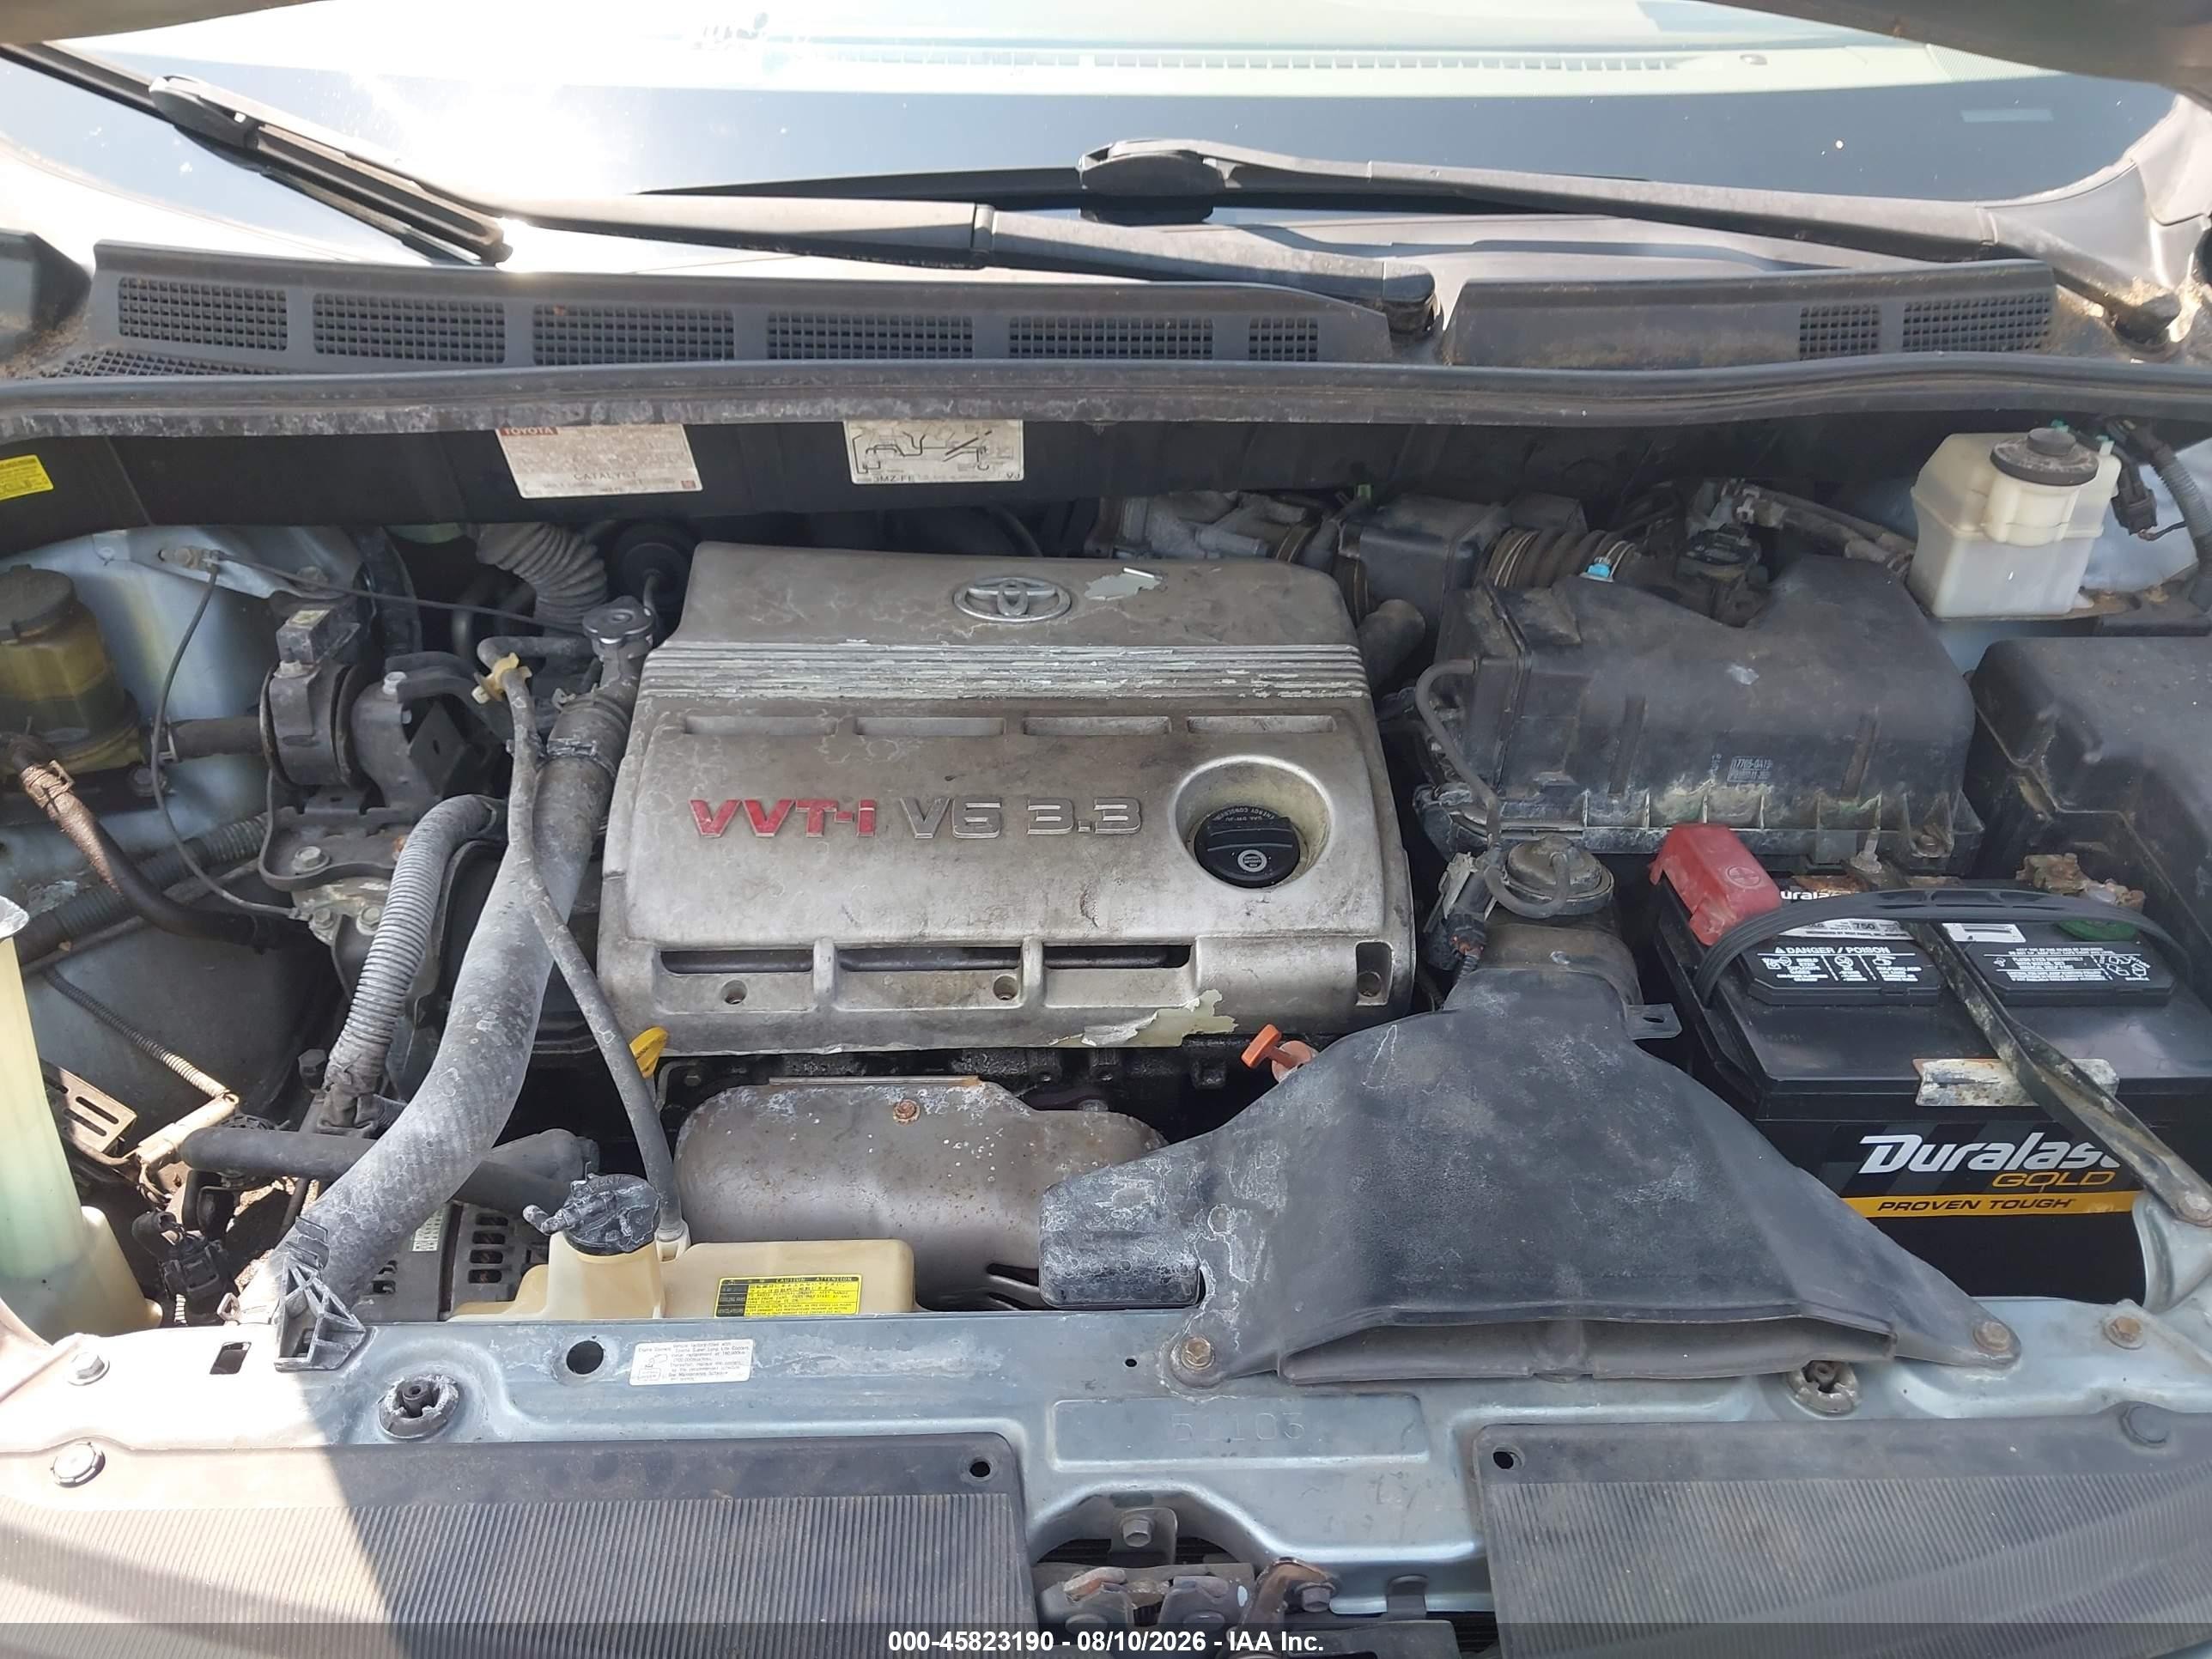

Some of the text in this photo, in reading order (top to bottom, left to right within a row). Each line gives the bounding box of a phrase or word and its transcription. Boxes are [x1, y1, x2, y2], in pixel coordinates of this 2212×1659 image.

[690, 797, 1141, 839] VVT-i V6 3.3
[1991, 1171, 2117, 1188] GOLD
[1878, 1200, 1981, 1212] PROVEN
